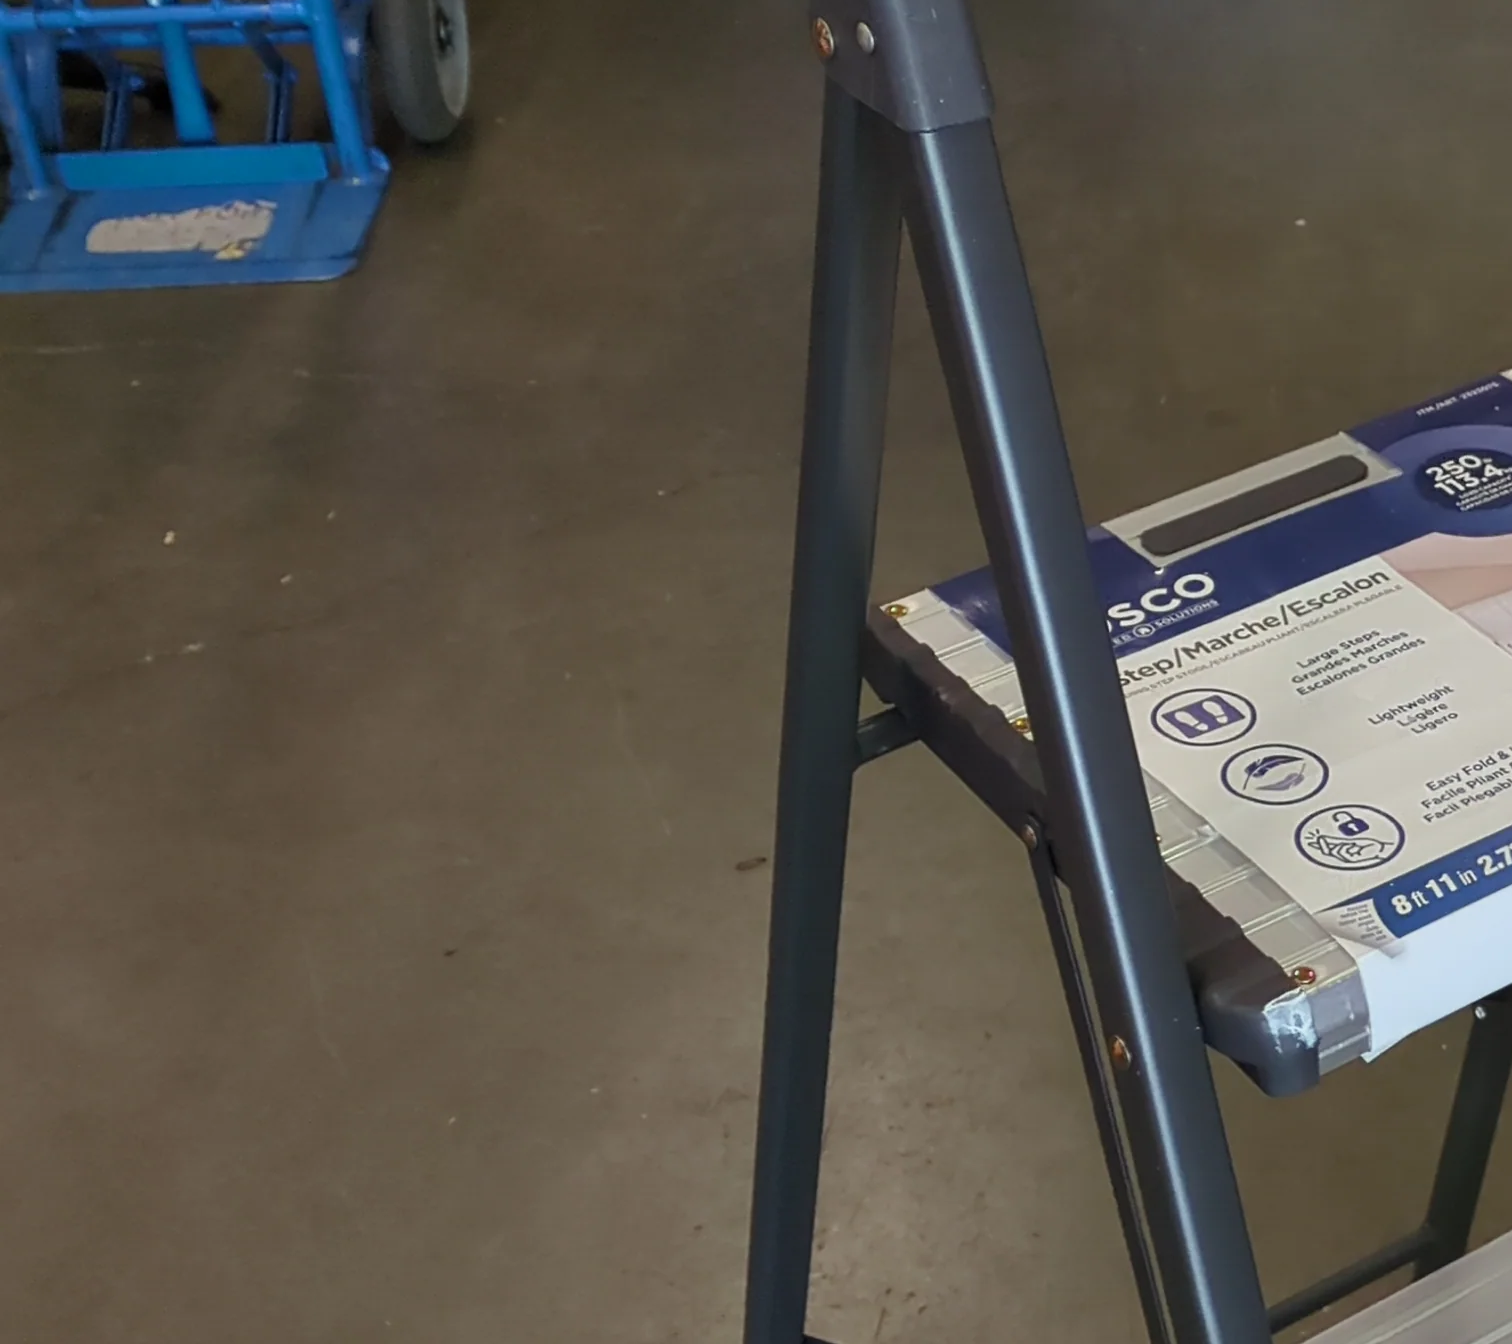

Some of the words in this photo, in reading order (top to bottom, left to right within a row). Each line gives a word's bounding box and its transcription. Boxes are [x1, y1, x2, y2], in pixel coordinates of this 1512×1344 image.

[1425, 454, 1482, 482] 250
[1434, 463, 1504, 495] 113.4
[1106, 573, 1215, 633] SCO
[1155, 599, 1219, 629] SOLUTIONS
[1291, 656, 1351, 684] Grandes
[1350, 630, 1410, 659] Marches
[1296, 647, 1339, 669] Large
[1339, 629, 1381, 651] Steps
[1296, 662, 1368, 696] Escalones
[1367, 637, 1426, 665] Grandes
[1367, 685, 1455, 726] Lightweight
[1410, 711, 1459, 735] Ligero
[1420, 786, 1466, 810] Facile
[1466, 767, 1510, 790] Pliant
[1425, 772, 1462, 792] Easy
[1461, 755, 1497, 776] Fold
[1497, 750, 1510, 761] &
[1391, 893, 1412, 916] 8
[1411, 890, 1429, 908] ft
[1425, 872, 1458, 899] 11
[1457, 869, 1477, 886] in
